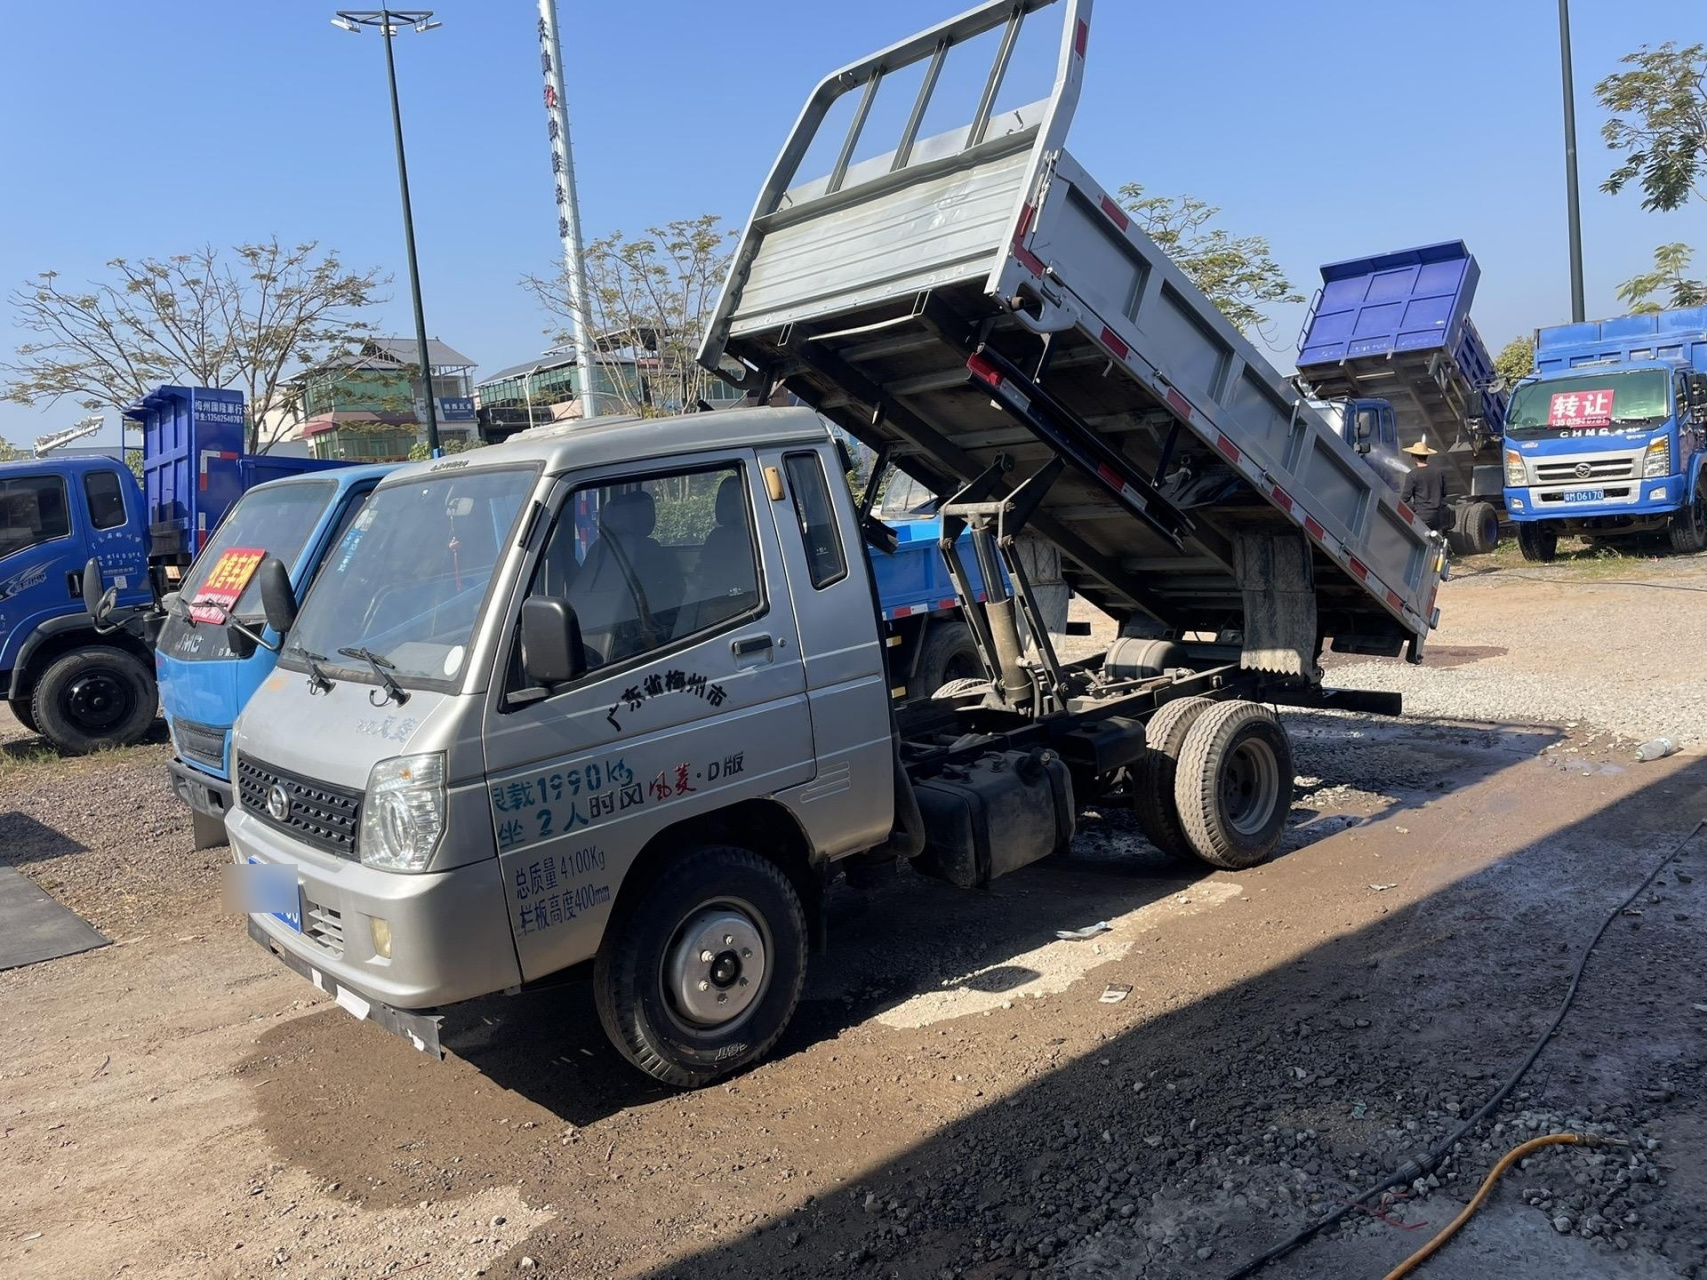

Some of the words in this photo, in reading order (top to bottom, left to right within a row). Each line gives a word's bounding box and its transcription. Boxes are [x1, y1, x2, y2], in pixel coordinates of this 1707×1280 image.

[1553, 393, 1608, 418] 转让
[606, 669, 727, 732] 广东省梅州市
